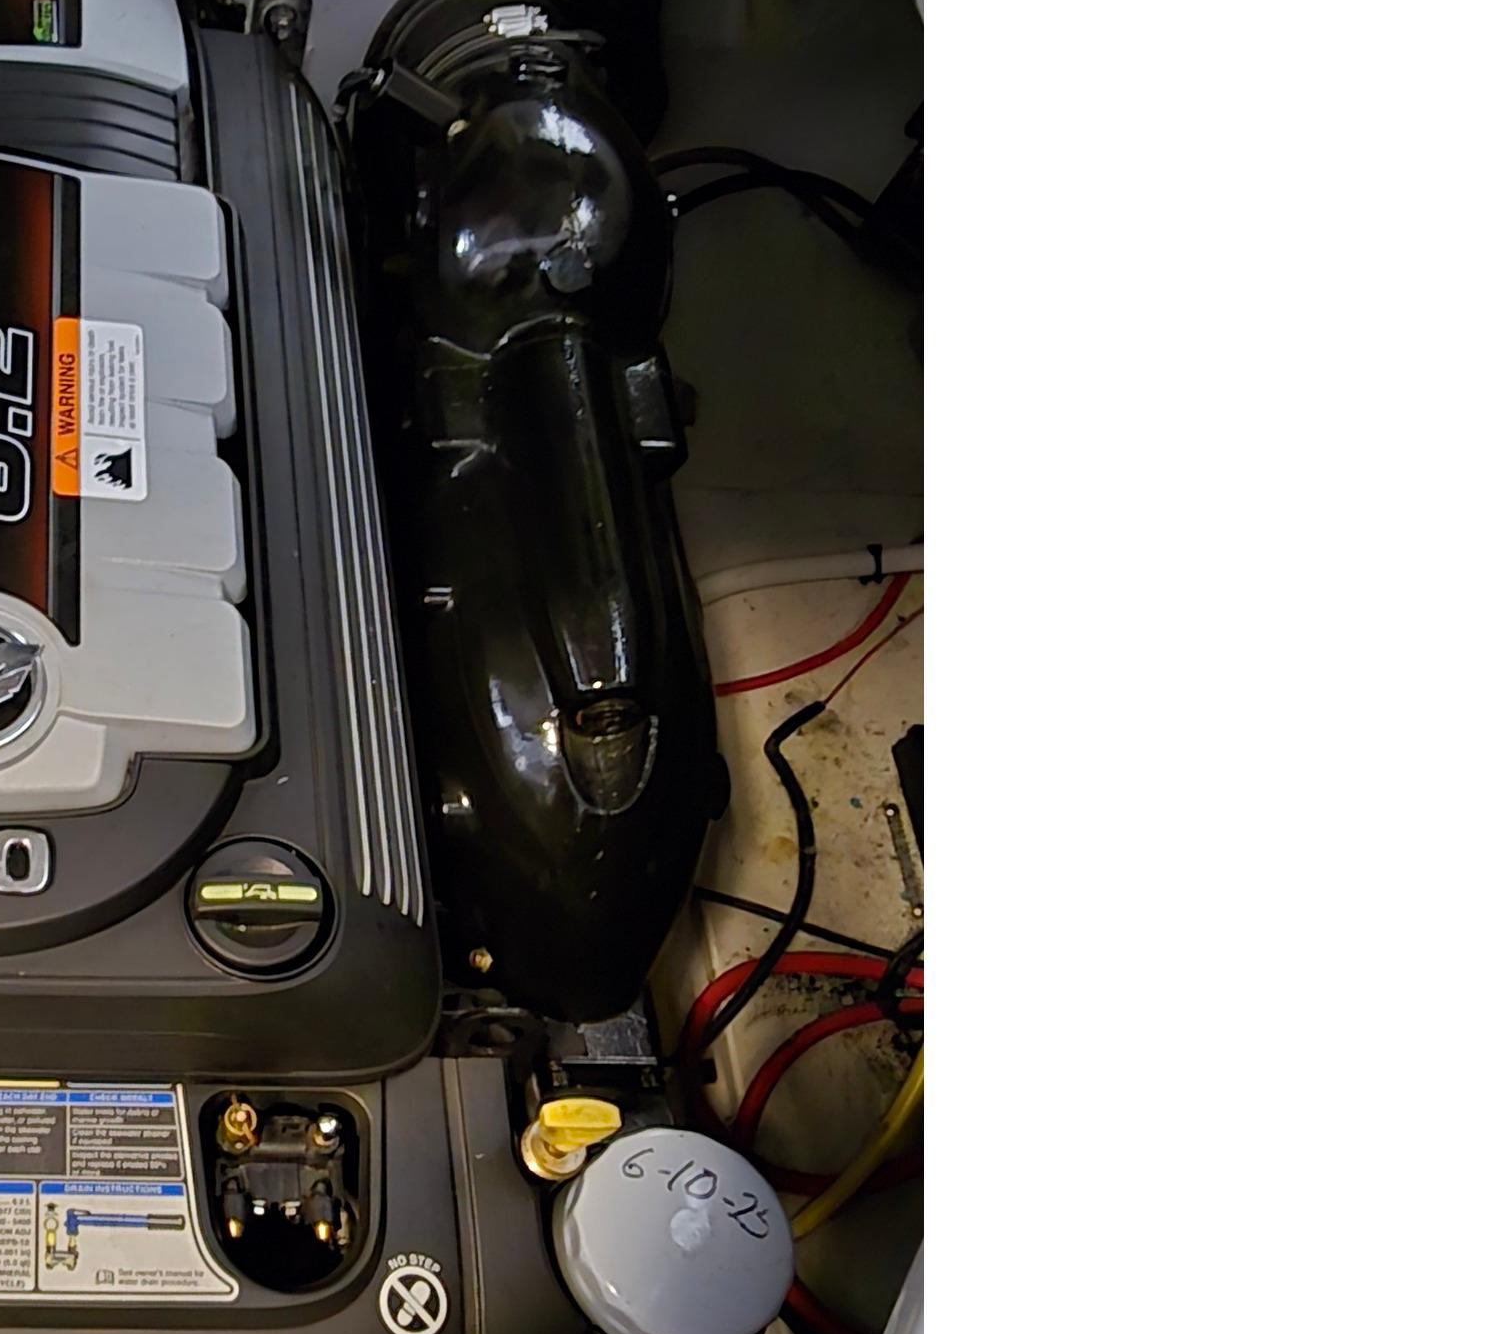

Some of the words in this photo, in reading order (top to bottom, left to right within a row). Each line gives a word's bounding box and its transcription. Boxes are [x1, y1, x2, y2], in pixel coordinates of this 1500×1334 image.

[58, 352, 76, 437] WARNING
[94, 1184, 162, 1194] INSTRUCTIONS
[387, 1254, 408, 1270] NO
[408, 1253, 441, 1273] STEP
